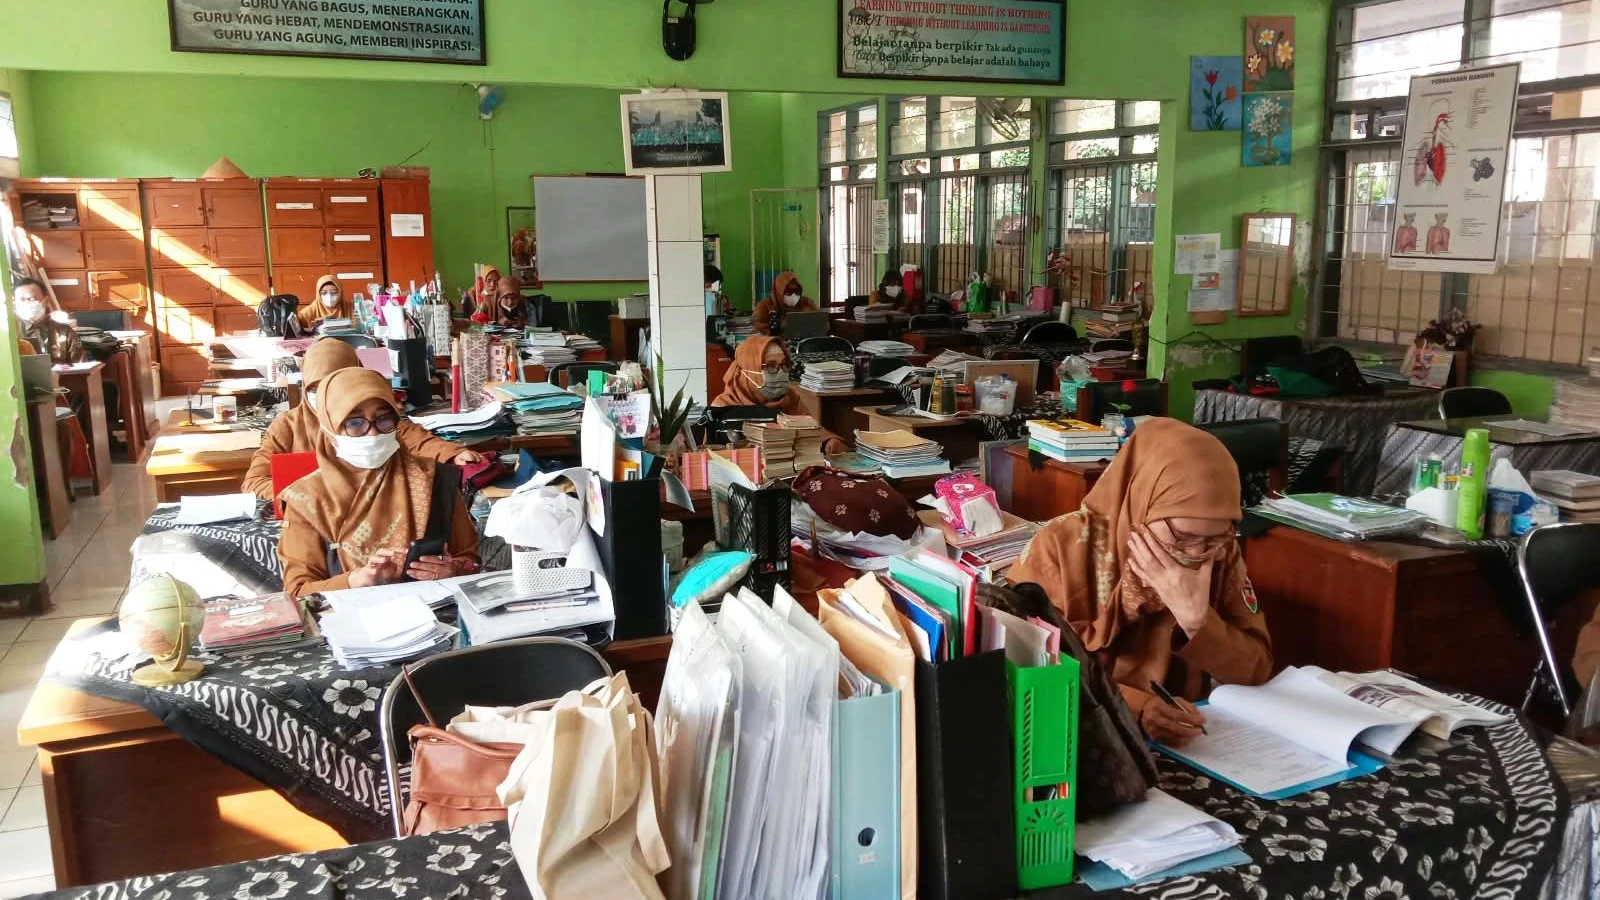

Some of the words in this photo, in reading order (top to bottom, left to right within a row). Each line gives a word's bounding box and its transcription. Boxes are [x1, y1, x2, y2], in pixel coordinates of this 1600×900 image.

[241, 0, 279, 9] GURU
[281, 0, 318, 11] YANG
[321, 1, 369, 15] BAGUS,
[372, 4, 473, 19] MENERANGKAN.
[905, 1, 946, 13] WITHOUT
[951, 4, 993, 16] THINKING
[193, 11, 232, 23] GURU
[235, 13, 273, 25] YANG
[276, 16, 321, 29] HEBAT,
[324, 18, 474, 36] MENDEMONSTRASIKAN.
[926, 18, 958, 29] WITHOUT
[214, 29, 252, 40] GURU
[255, 30, 292, 42] YANG
[295, 32, 347, 46] AGUNG,
[350, 35, 408, 48] MEMBERI
[411, 38, 475, 51] INSPIRASI.
[853, 34, 897, 50] Belajar
[897, 39, 932, 52] tanpa
[935, 39, 984, 53] berpikir
[985, 43, 999, 52] Tak
[1000, 44, 1016, 53] ada
[878, 51, 921, 64] Berpikir
[921, 53, 949, 65] tanpa
[951, 54, 985, 67] belajar
[985, 56, 1017, 67] adalah
[1018, 58, 1051, 70] bahaya
